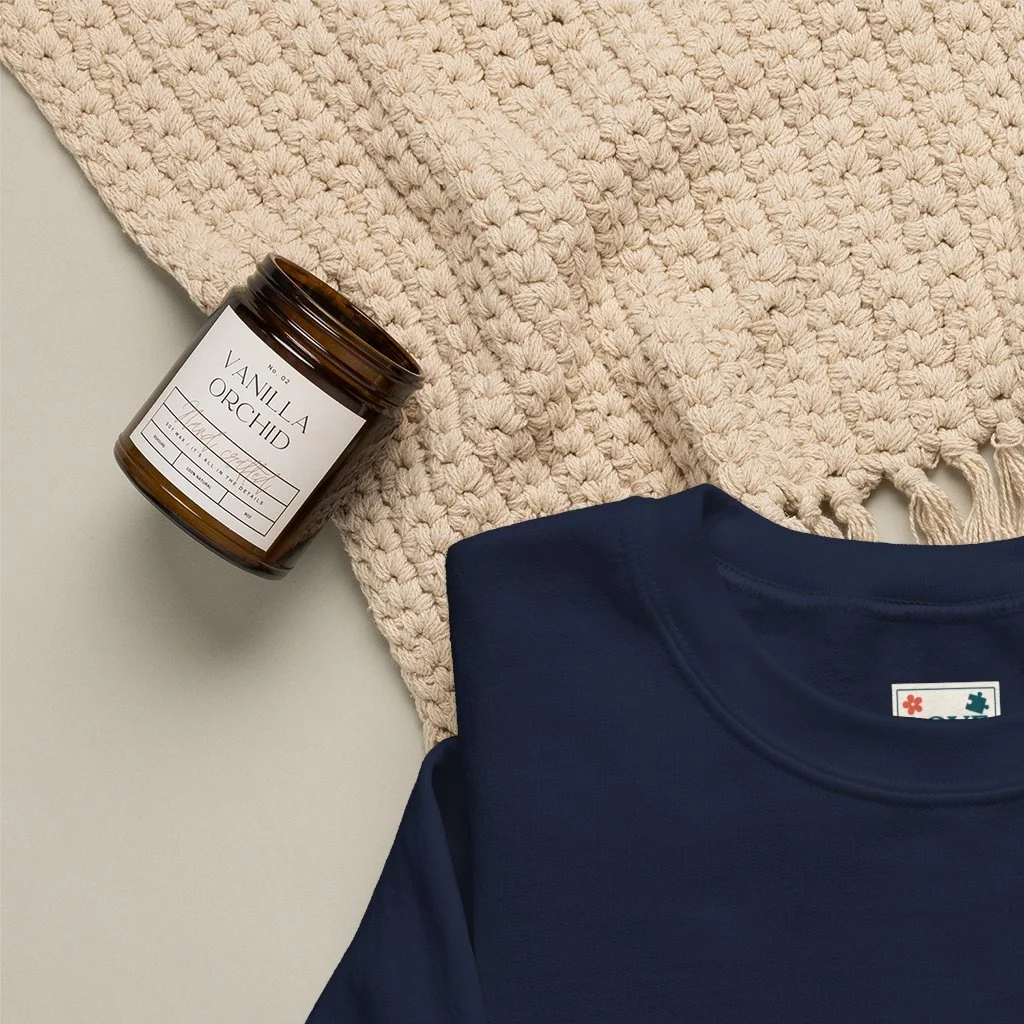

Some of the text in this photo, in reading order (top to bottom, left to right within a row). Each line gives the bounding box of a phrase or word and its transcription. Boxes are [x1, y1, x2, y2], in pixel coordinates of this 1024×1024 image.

[209, 377, 290, 450] ORCHID
[224, 349, 309, 434] VANILLA
[280, 374, 291, 385] 02
[165, 421, 175, 431] SOY
[175, 431, 186, 442] WAX
[203, 458, 214, 469] ALL
[225, 475, 237, 486] THE
[238, 485, 264, 506] DETAILS
